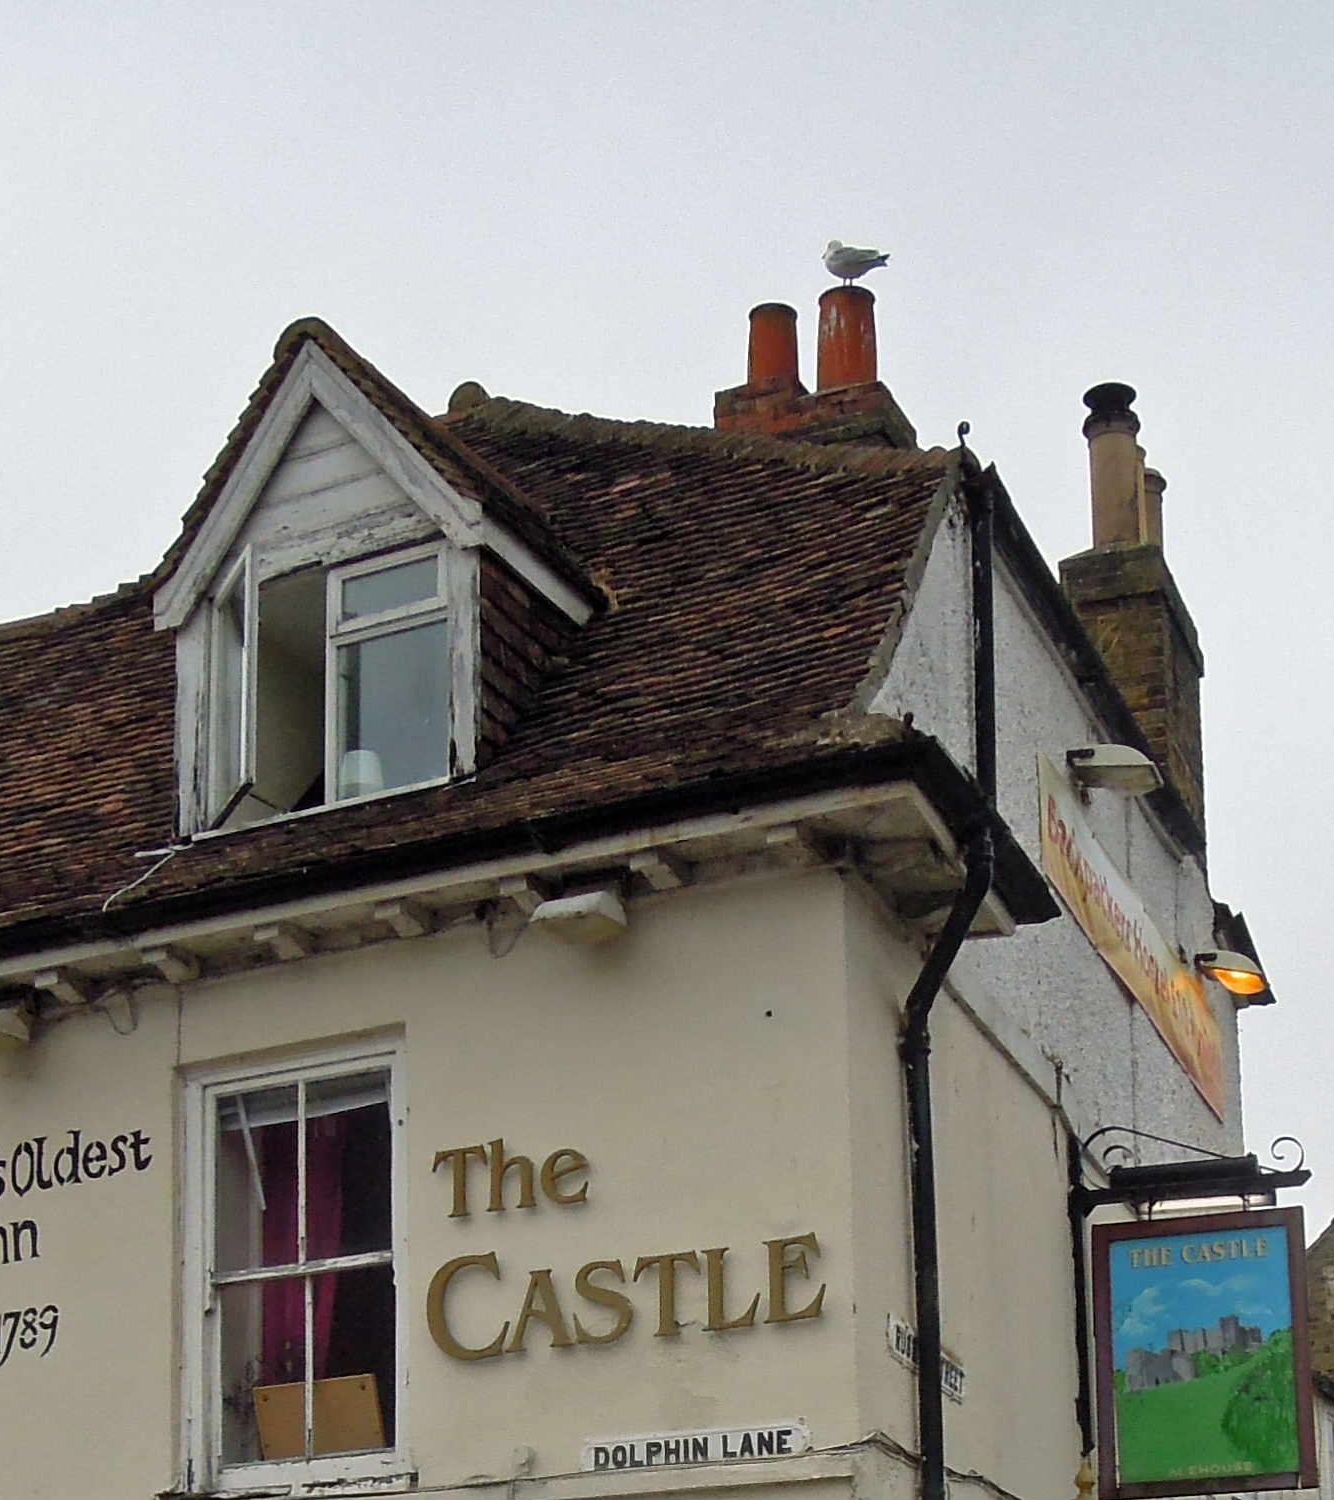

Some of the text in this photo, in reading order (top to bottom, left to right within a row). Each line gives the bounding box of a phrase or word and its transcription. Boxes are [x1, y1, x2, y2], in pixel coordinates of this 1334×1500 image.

[11, 1129, 153, 1198] Oldest
[432, 1138, 590, 1218] The
[1130, 1237, 1269, 1268] THE CASTLE
[426, 1232, 827, 1361] CASTLE
[593, 1428, 793, 1470] DOLPHIN LANE
[1168, 1462, 1253, 1477] ALEHOUSE
